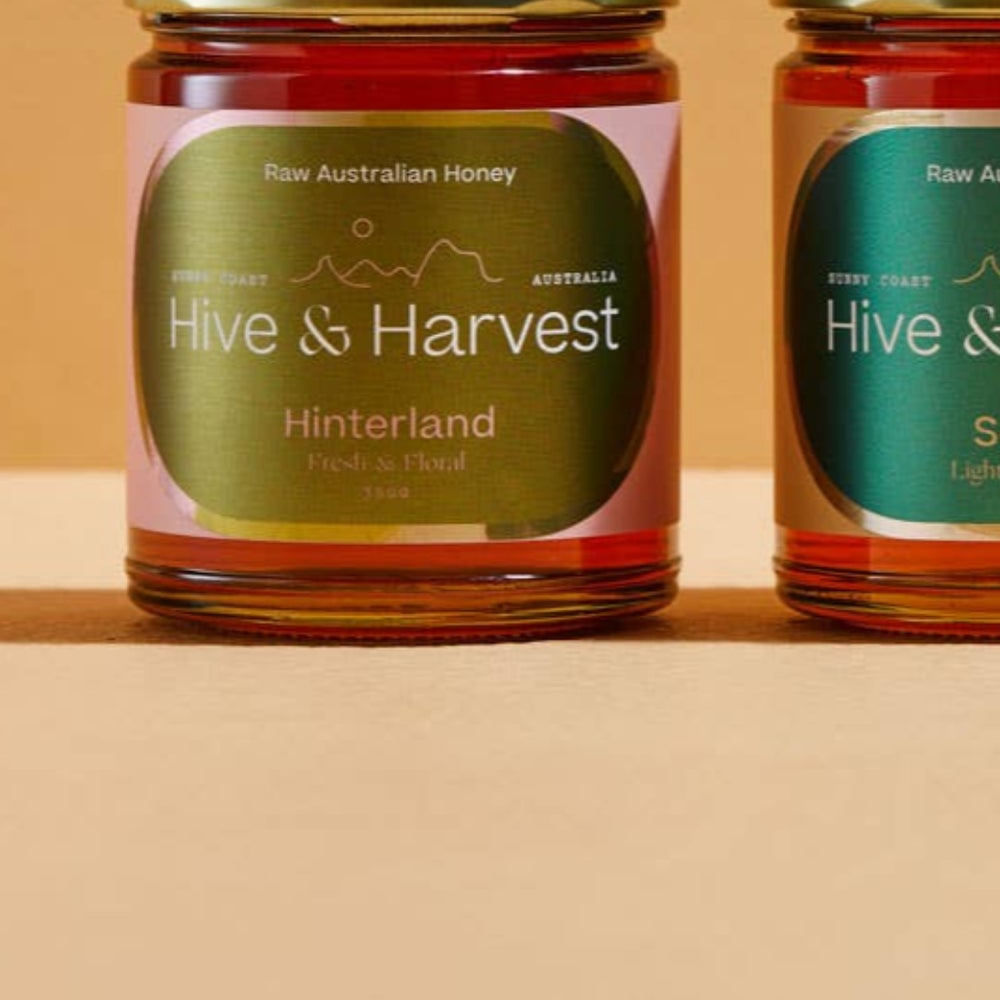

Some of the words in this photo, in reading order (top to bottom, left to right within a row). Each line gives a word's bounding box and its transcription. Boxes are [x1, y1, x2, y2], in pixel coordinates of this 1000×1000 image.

[264, 163, 309, 183] Raw
[317, 163, 437, 183] Australian
[444, 163, 517, 186] Honey
[926, 163, 972, 183] Raw
[532, 270, 617, 286] AUSTRALIA
[880, 275, 932, 287] COAST
[169, 297, 279, 355] Hive
[299, 304, 351, 356] &
[373, 296, 620, 356] Harvest
[827, 299, 942, 355] Hive
[284, 405, 496, 440] Hinterland
[308, 453, 368, 471] Fresh
[403, 450, 466, 471] Floral
